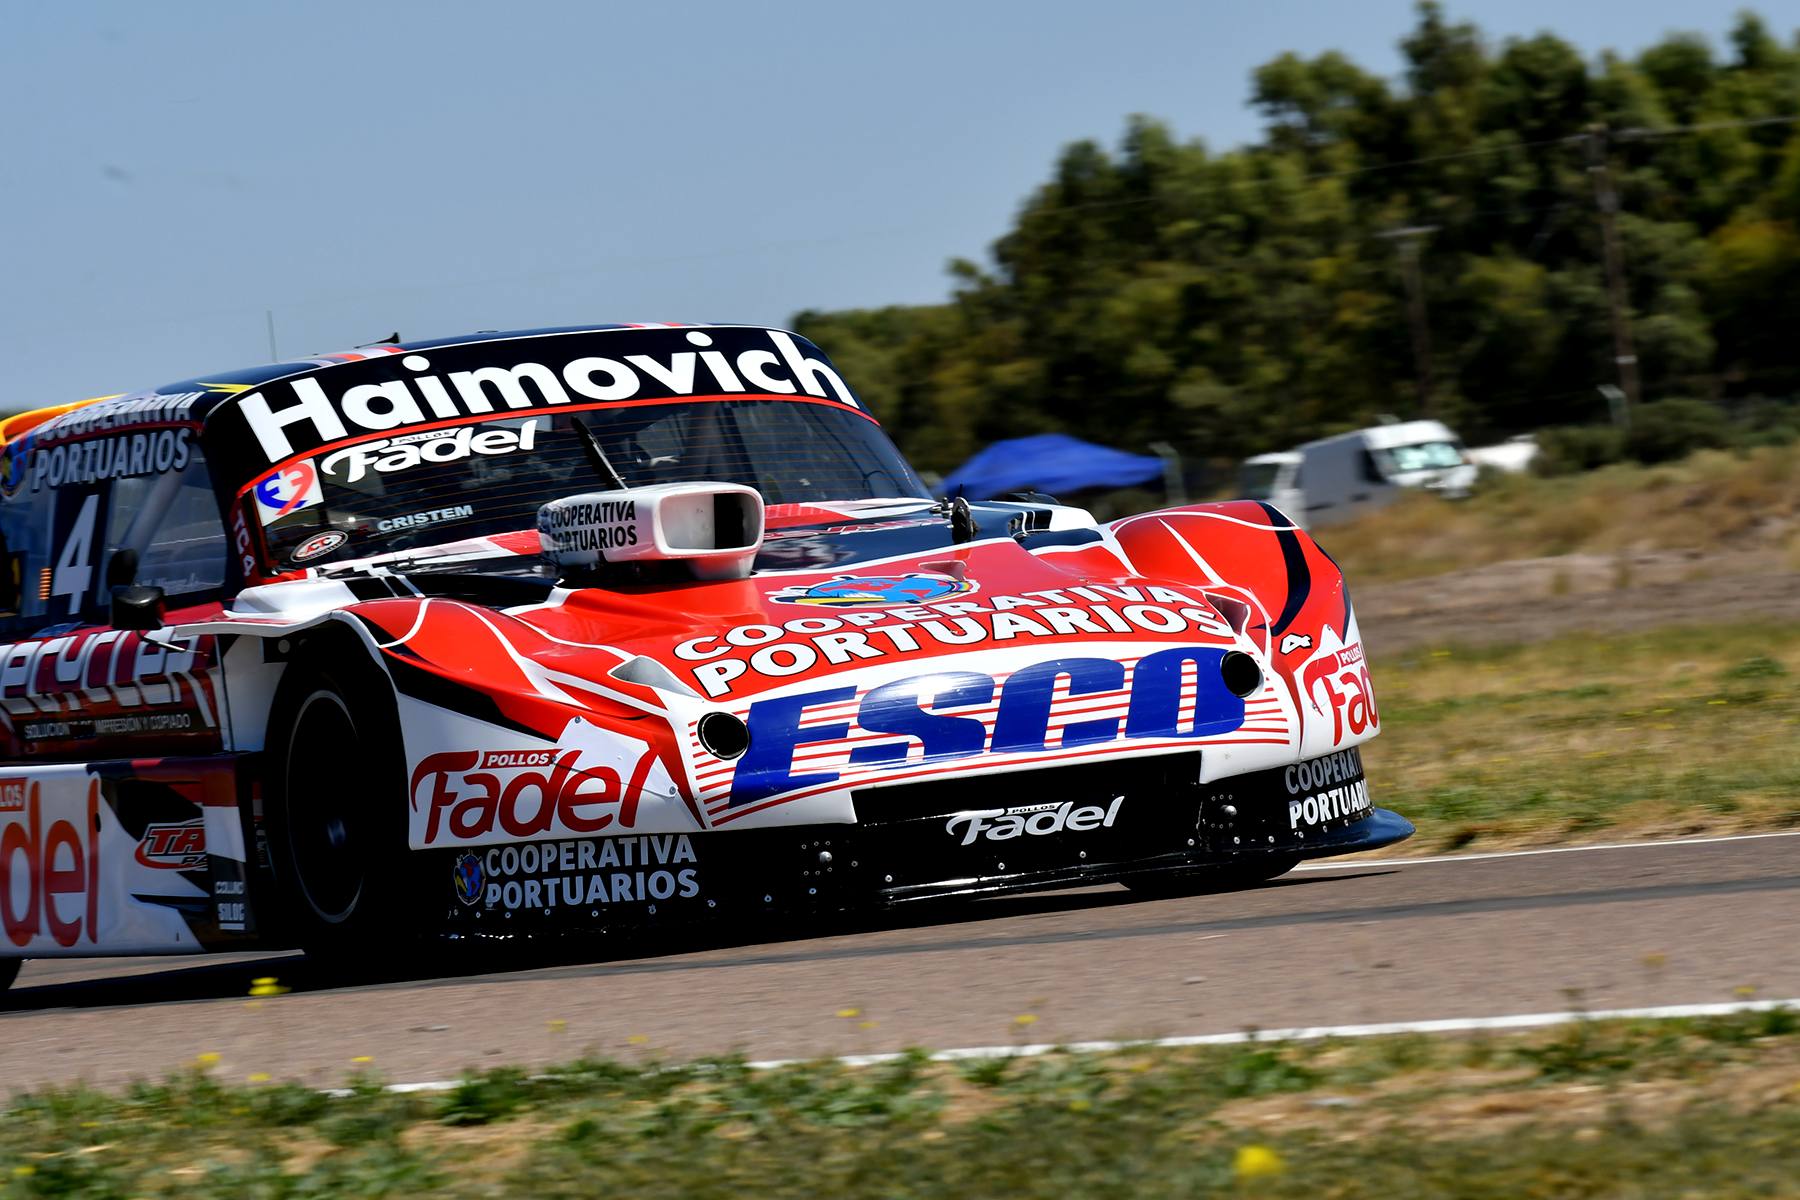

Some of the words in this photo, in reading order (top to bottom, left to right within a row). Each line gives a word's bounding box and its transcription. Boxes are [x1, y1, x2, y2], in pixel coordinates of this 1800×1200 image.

[238, 330, 859, 463] Haimovich
[32, 428, 191, 490] PORTUARIOS
[321, 419, 538, 483] Fadel
[377, 505, 473, 531] CRISTEM
[551, 500, 636, 528] COOPERATIVA
[52, 494, 100, 615] 4
[672, 585, 1207, 661] COOPERATIVA
[691, 604, 1235, 699] PORTUARIOS
[727, 646, 1246, 808] ESCO
[486, 752, 549, 767] POLLOS
[410, 748, 652, 844] Fadel
[946, 796, 1125, 846] Fadel
[1011, 804, 1056, 814] POLLOS
[485, 834, 698, 877] COOPERATIVA
[485, 869, 700, 910] PORTUARIOS
